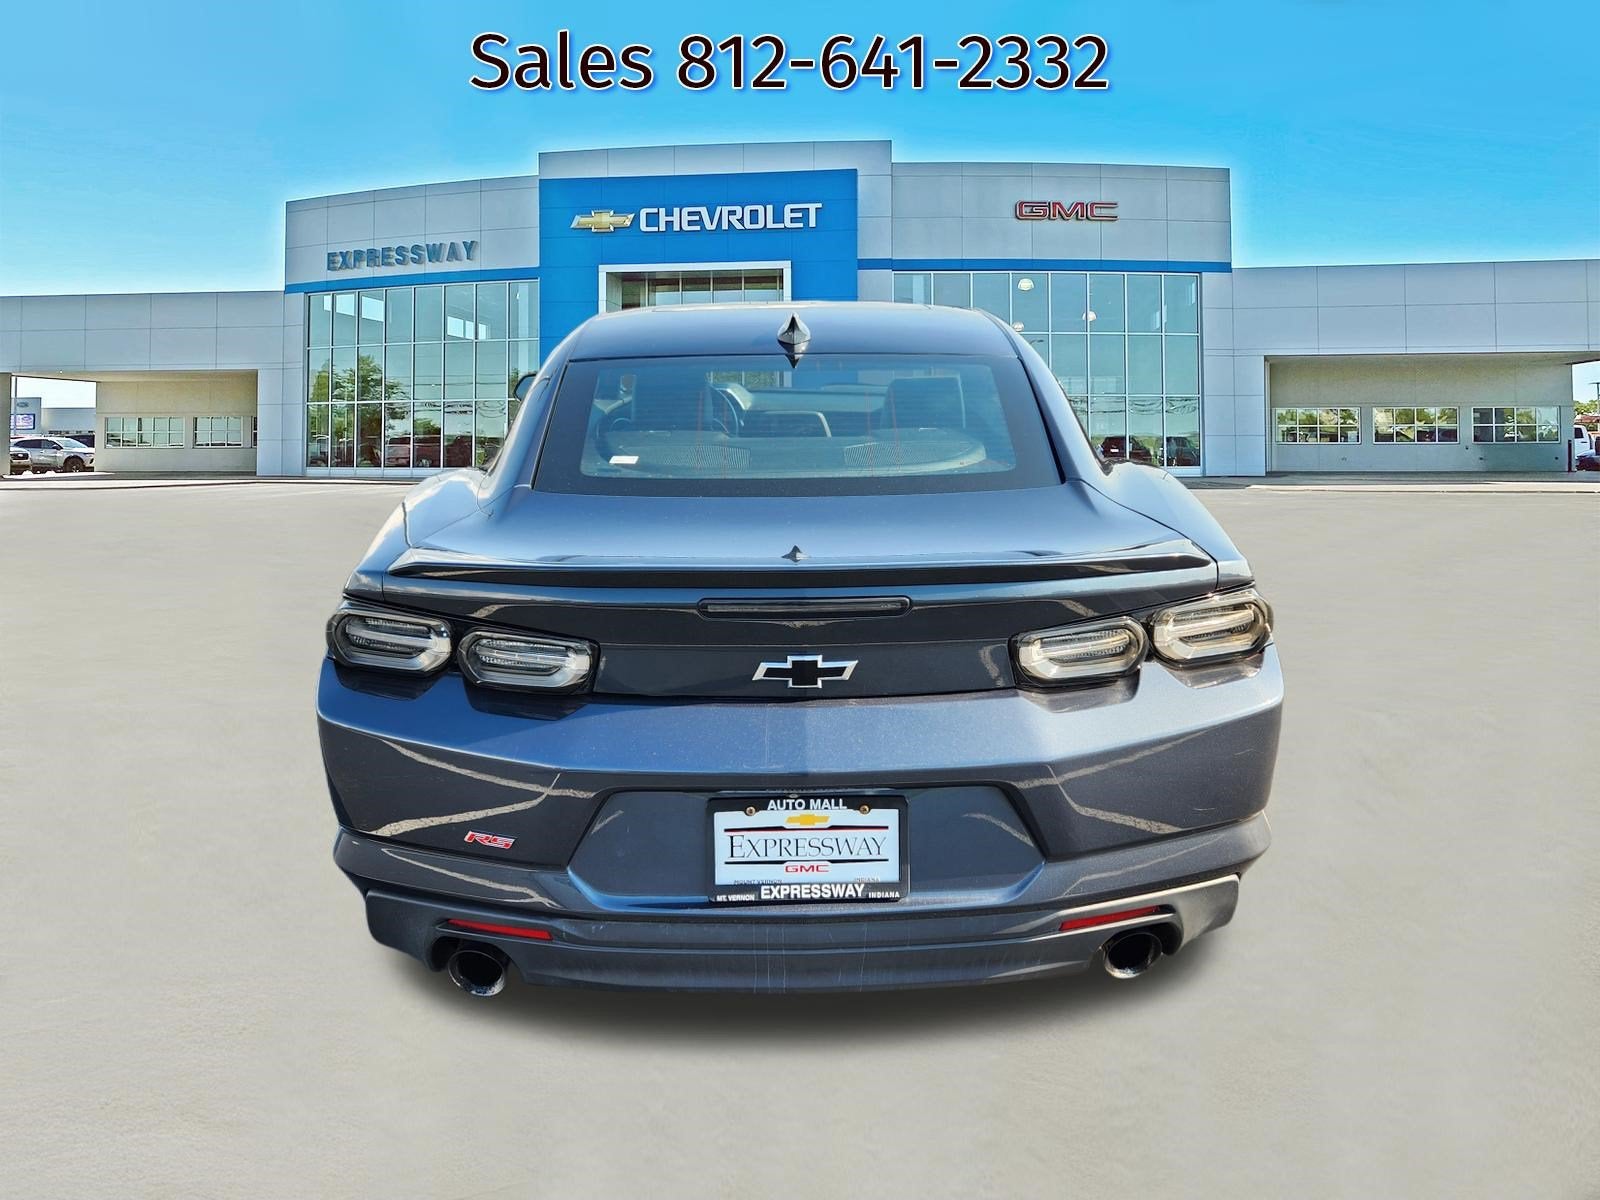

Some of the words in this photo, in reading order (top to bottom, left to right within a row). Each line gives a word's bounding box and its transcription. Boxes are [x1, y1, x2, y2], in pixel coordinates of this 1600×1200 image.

[639, 202, 823, 233] CHEVROLET
[1015, 200, 1119, 221] GMC
[327, 240, 479, 271] EXPRESSWAY
[767, 799, 806, 811] AUTO
[809, 799, 847, 810] MALL
[464, 830, 516, 849] RS
[785, 865, 829, 873] GMC
[760, 884, 865, 900] EXPRESSWAY
